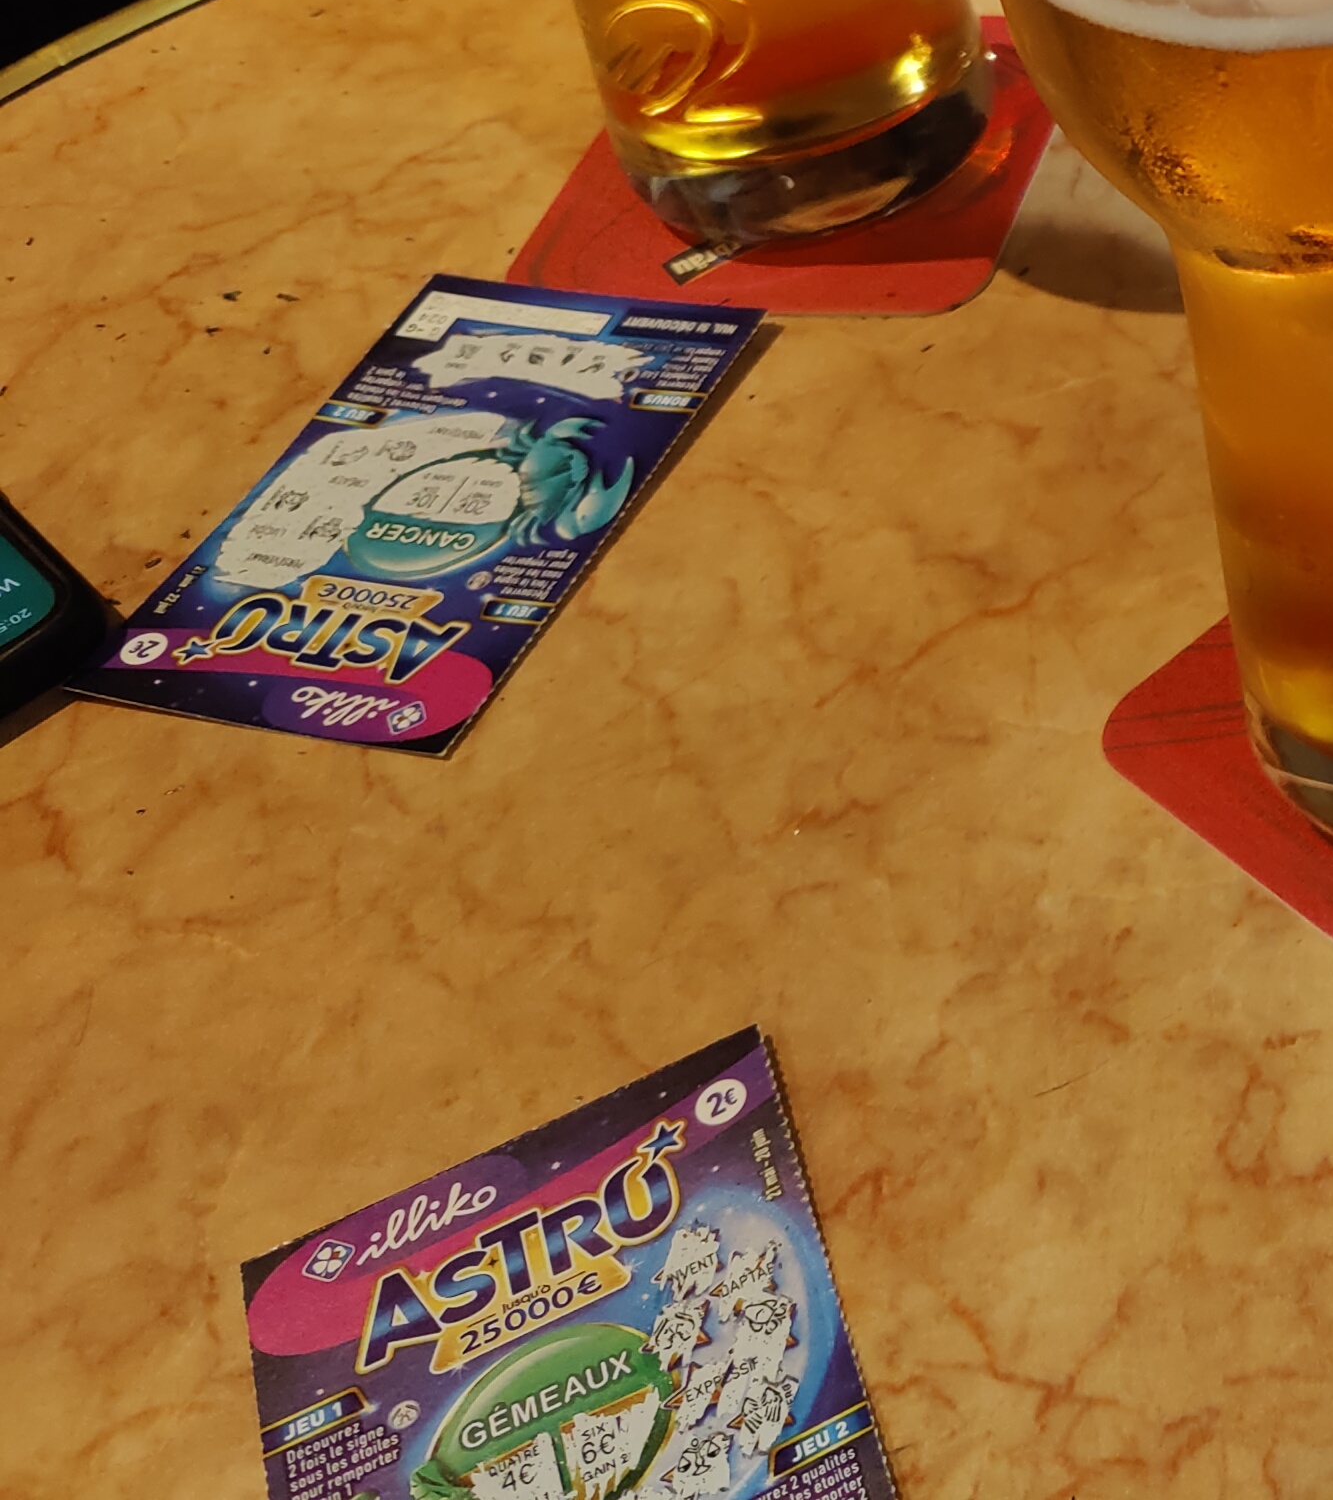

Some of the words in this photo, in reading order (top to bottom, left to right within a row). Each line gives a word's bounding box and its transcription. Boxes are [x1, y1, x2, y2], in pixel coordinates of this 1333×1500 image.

[330, 406, 347, 416] 2
[343, 408, 376, 421] JEU
[640, 393, 692, 406] BONUS
[403, 490, 440, 509] 10€
[362, 521, 478, 550] CANCER
[505, 604, 538, 618] JEU
[125, 638, 161, 658] 2€
[211, 597, 464, 680] ASTRO
[289, 687, 401, 725] illiko
[706, 1089, 738, 1118] 2€
[748, 1126, 771, 1150] juin
[753, 1146, 771, 1163] 20
[758, 1165, 778, 1188] mai
[763, 1184, 782, 1201] 21
[356, 1182, 496, 1263] illiko
[363, 1159, 676, 1368] ASTRO
[461, 1351, 632, 1449] GÉMEAUX
[283, 1408, 325, 1441] JEU
[331, 1400, 342, 1415] 1
[581, 1423, 607, 1441] SIX
[285, 1422, 361, 1465] Découvrez
[287, 1465, 297, 1478] 2
[300, 1454, 327, 1472] fois
[329, 1447, 344, 1459] le
[347, 1426, 385, 1452] signe
[581, 1432, 616, 1465] 6€
[792, 1429, 831, 1463] JEU
[834, 1421, 850, 1439] 2
[289, 1468, 324, 1493] sous
[326, 1460, 349, 1476] les
[351, 1433, 399, 1464] étoiles
[327, 1449, 400, 1490] remporter
[488, 1444, 540, 1477] QUATRE
[583, 1459, 616, 1483] GAIN
[789, 1476, 800, 1491] 2
[801, 1448, 856, 1486] qualités
[502, 1463, 538, 1491] 4€
[814, 1461, 860, 1494] étoiles
